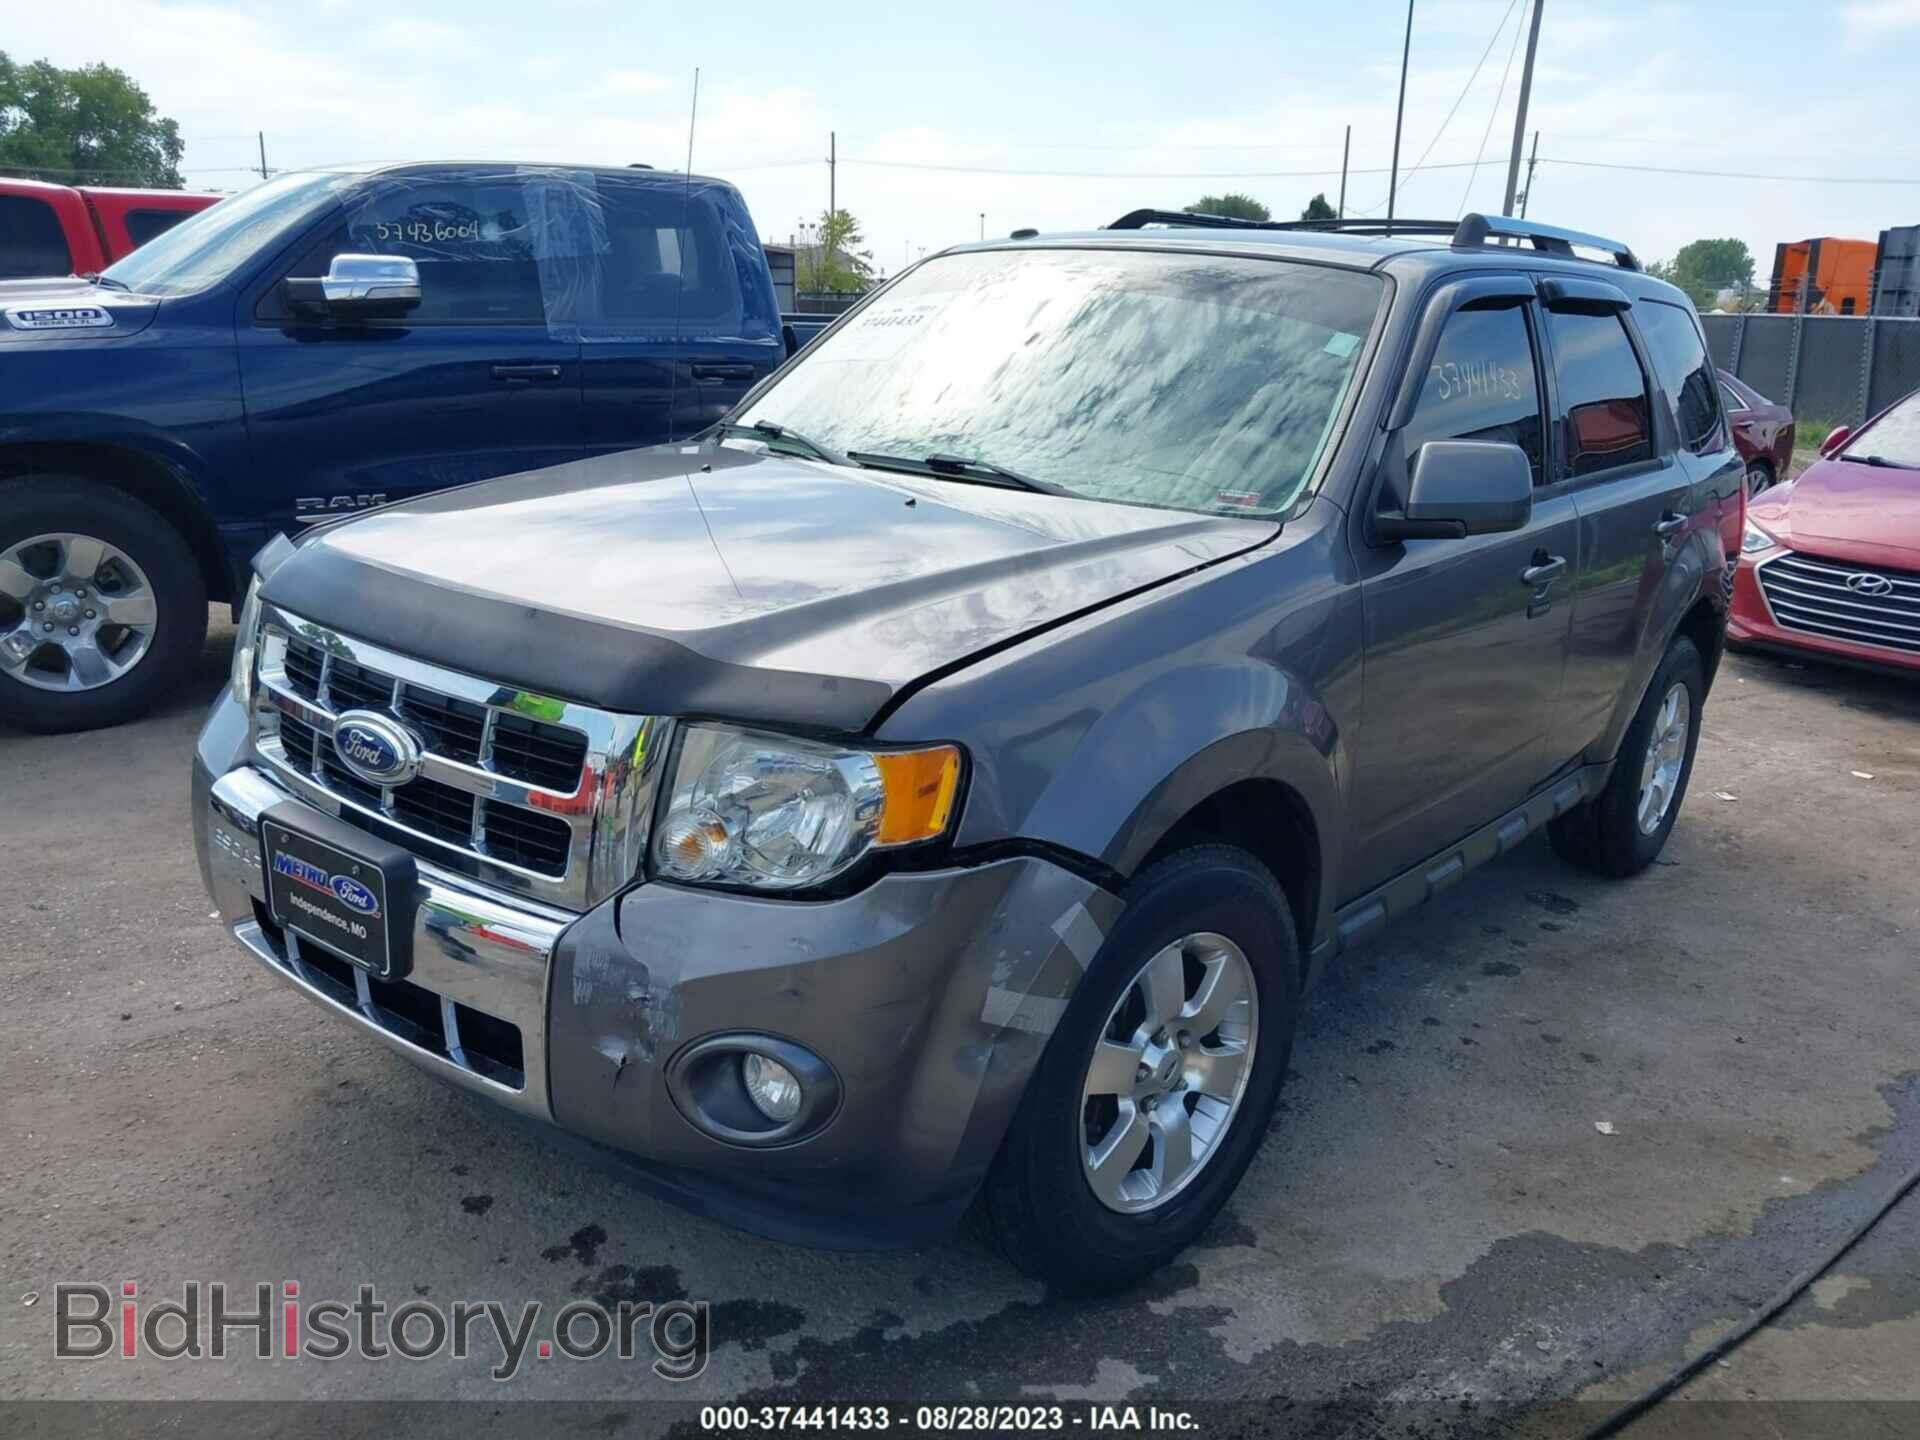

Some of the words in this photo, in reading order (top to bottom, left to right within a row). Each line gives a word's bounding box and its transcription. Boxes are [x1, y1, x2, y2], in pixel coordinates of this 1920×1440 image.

[22, 310, 97, 320] 1500
[295, 493, 387, 510] RAM
[344, 728, 383, 766] Ford
[273, 850, 329, 888] METRO
[339, 881, 368, 909] Ford
[289, 891, 350, 934] Independence,
[350, 920, 367, 940] MO
